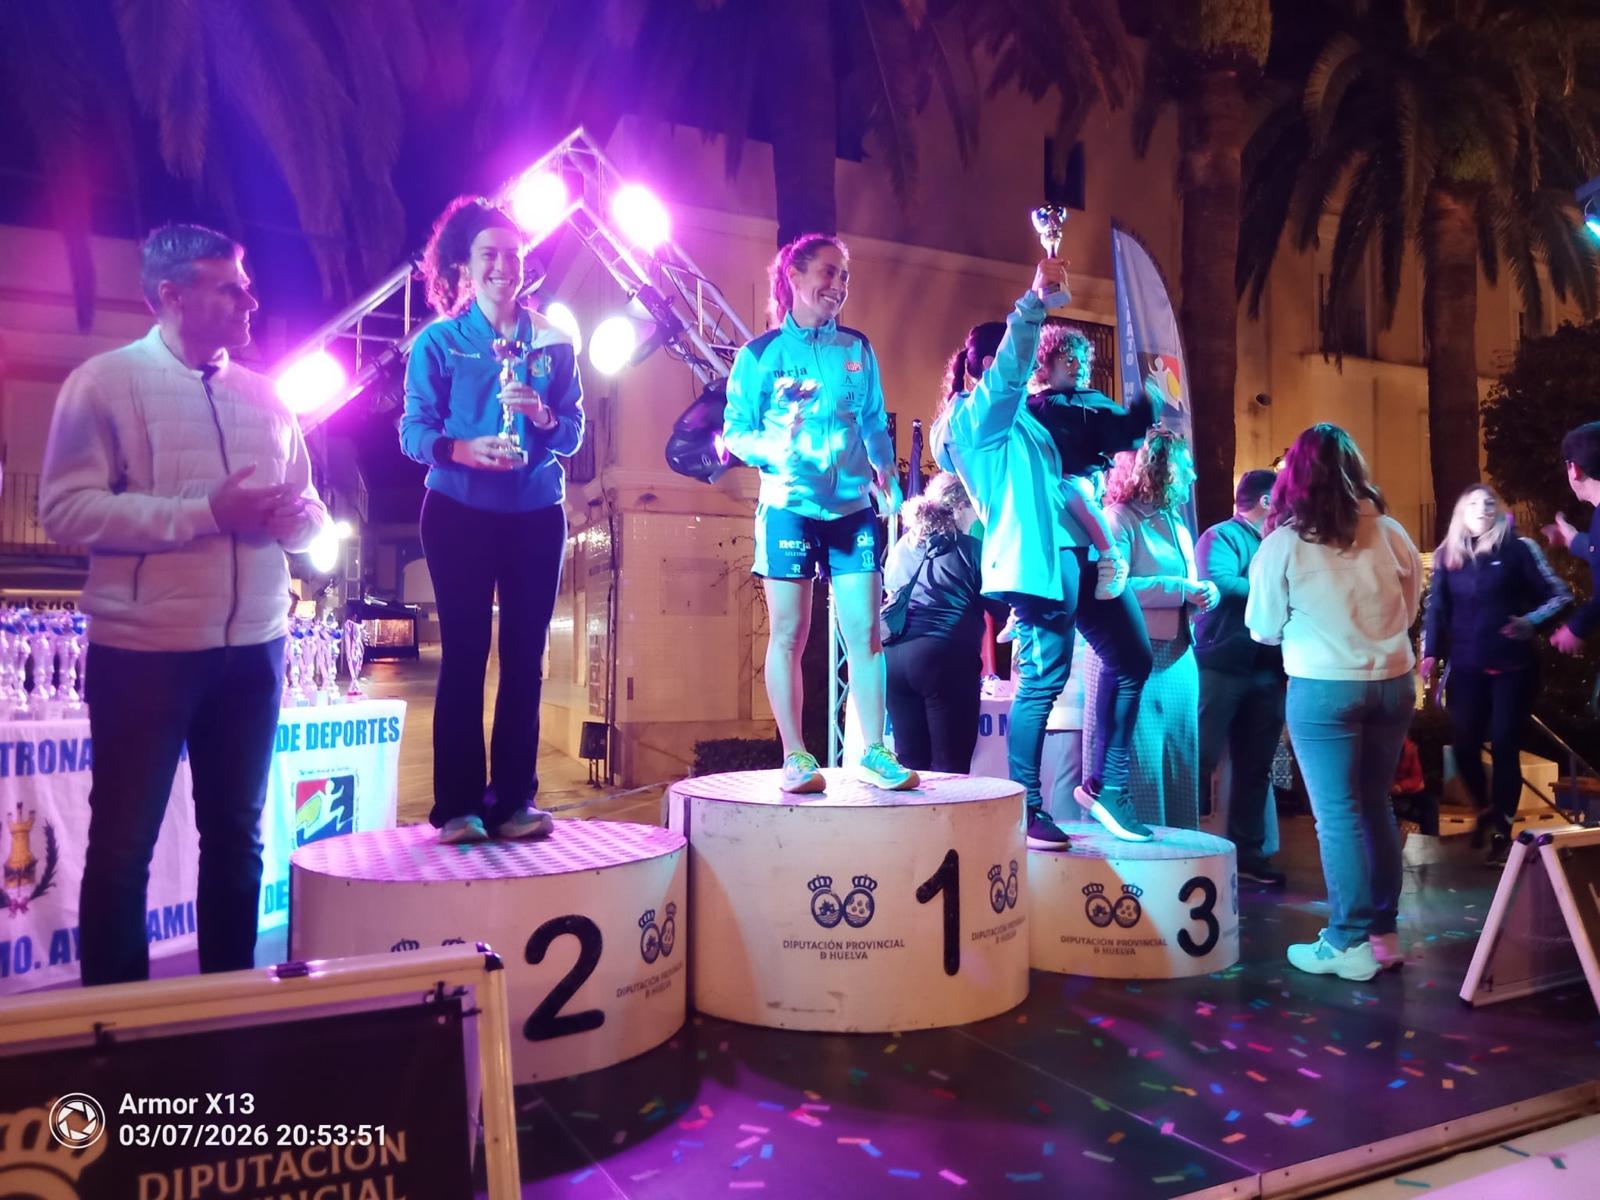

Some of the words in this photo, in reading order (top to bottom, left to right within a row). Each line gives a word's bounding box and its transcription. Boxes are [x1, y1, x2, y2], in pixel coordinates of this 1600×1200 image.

[779, 539, 811, 551] nerja
[276, 723, 300, 753] DE
[306, 716, 400, 751] DEPORTES
[916, 849, 960, 976] 1
[1177, 876, 1219, 957] 3
[783, 939, 843, 950] DIPUTACIÓN
[846, 939, 905, 950] PROVINCIAL
[829, 951, 869, 960] HUELVA
[523, 915, 605, 1041] 2
